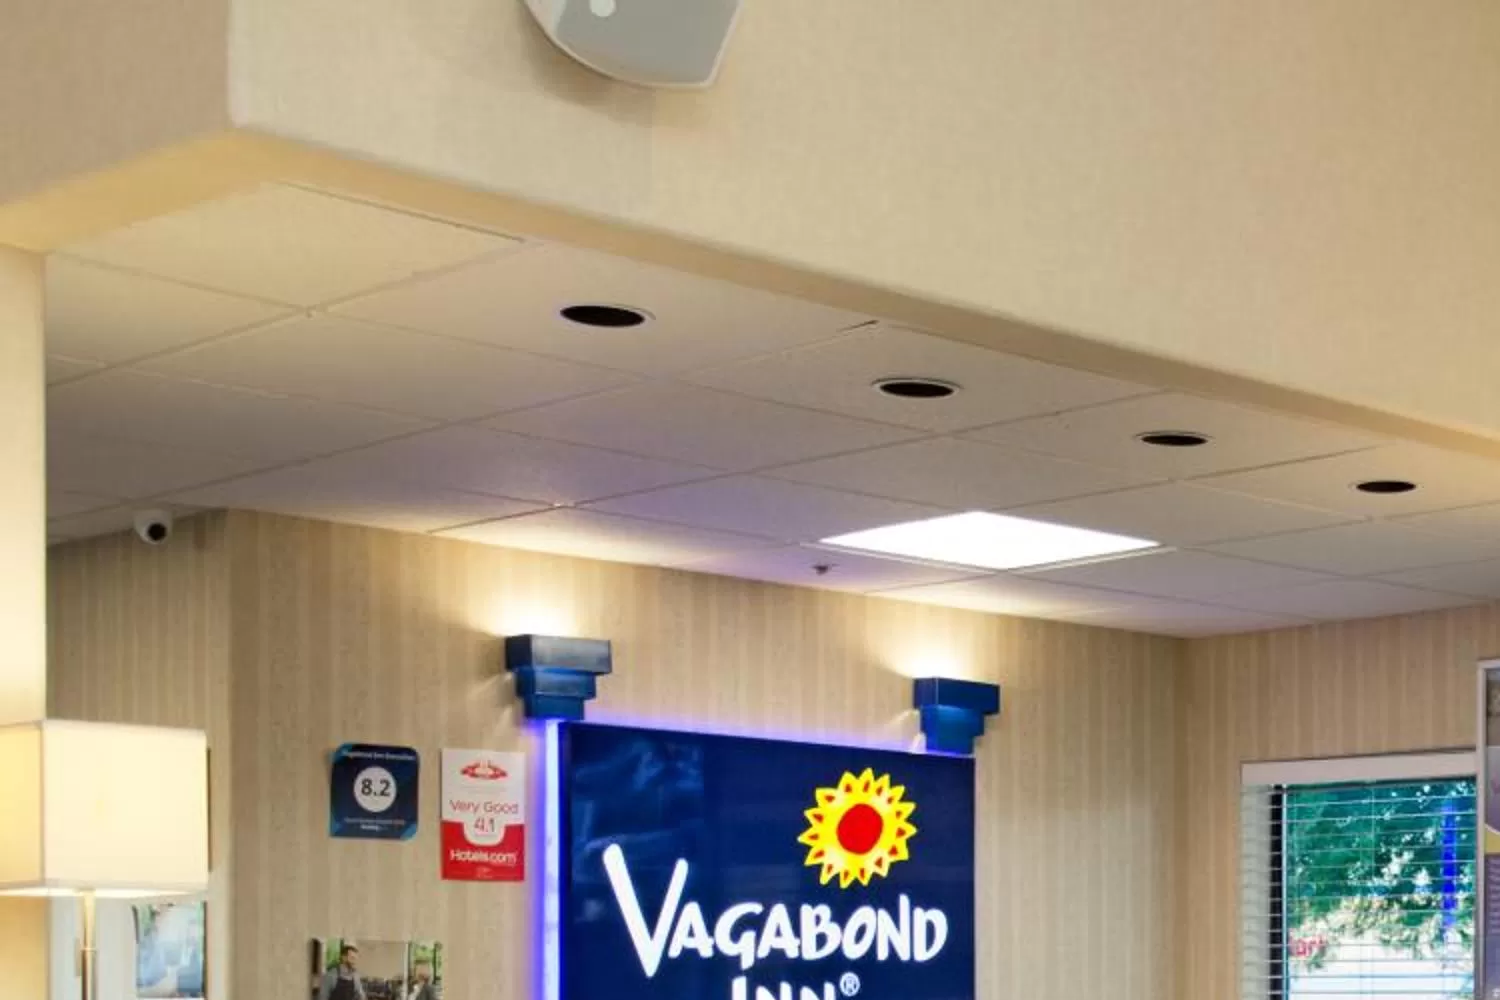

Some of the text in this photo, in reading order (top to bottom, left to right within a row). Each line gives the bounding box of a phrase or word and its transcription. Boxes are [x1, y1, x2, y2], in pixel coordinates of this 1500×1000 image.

[360, 778, 391, 797] 8.2
[448, 799, 519, 816] Very Good
[473, 817, 496, 833] 4.1
[602, 843, 949, 979] VAGABOND
